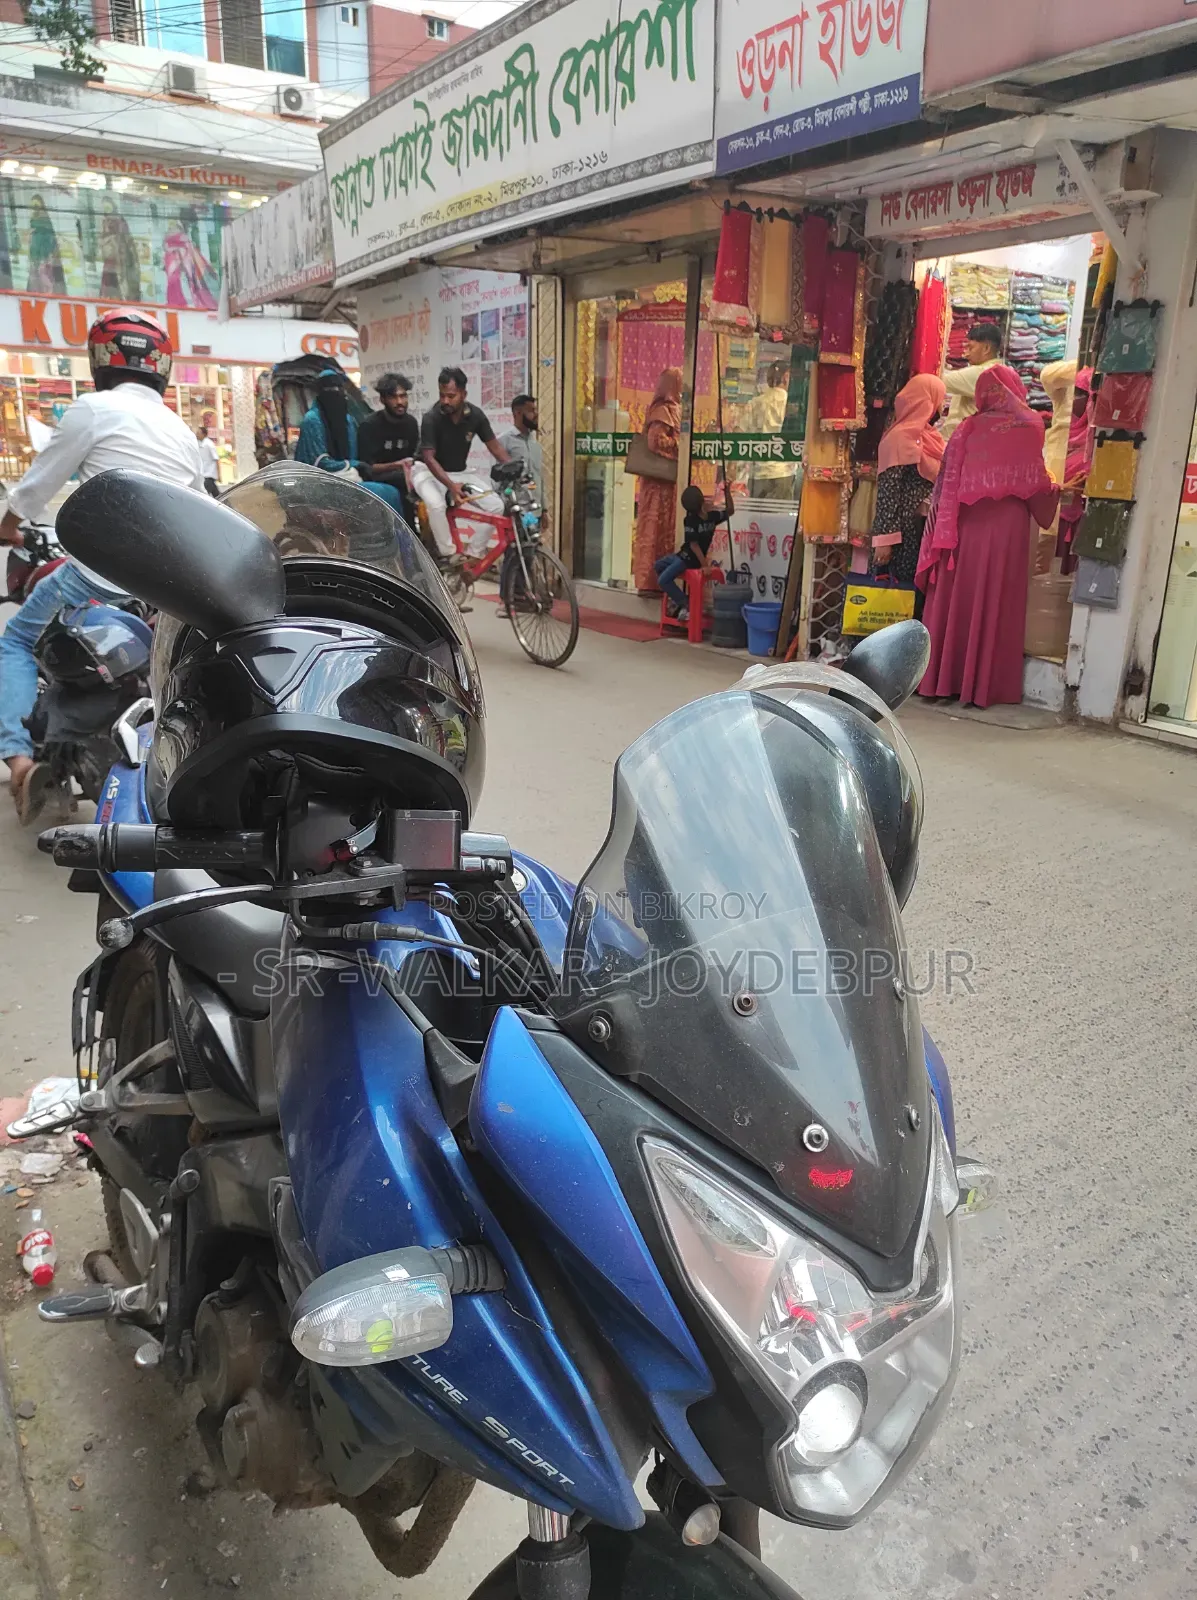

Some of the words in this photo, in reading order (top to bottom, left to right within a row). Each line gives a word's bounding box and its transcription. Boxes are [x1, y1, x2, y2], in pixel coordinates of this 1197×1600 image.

[736, 5, 809, 112] ওড়না
[379, 99, 437, 201] ঢাকাই
[440, 42, 540, 178] জামদানী
[86, 153, 185, 181] BENARASI
[191, 169, 247, 189] KUTHI
[552, 150, 608, 180] ঢাকা-১২১৬
[20, 300, 179, 352] KUI
[737, 435, 786, 459] ঢাকাই
[480, 1415, 575, 1488] SPORT
